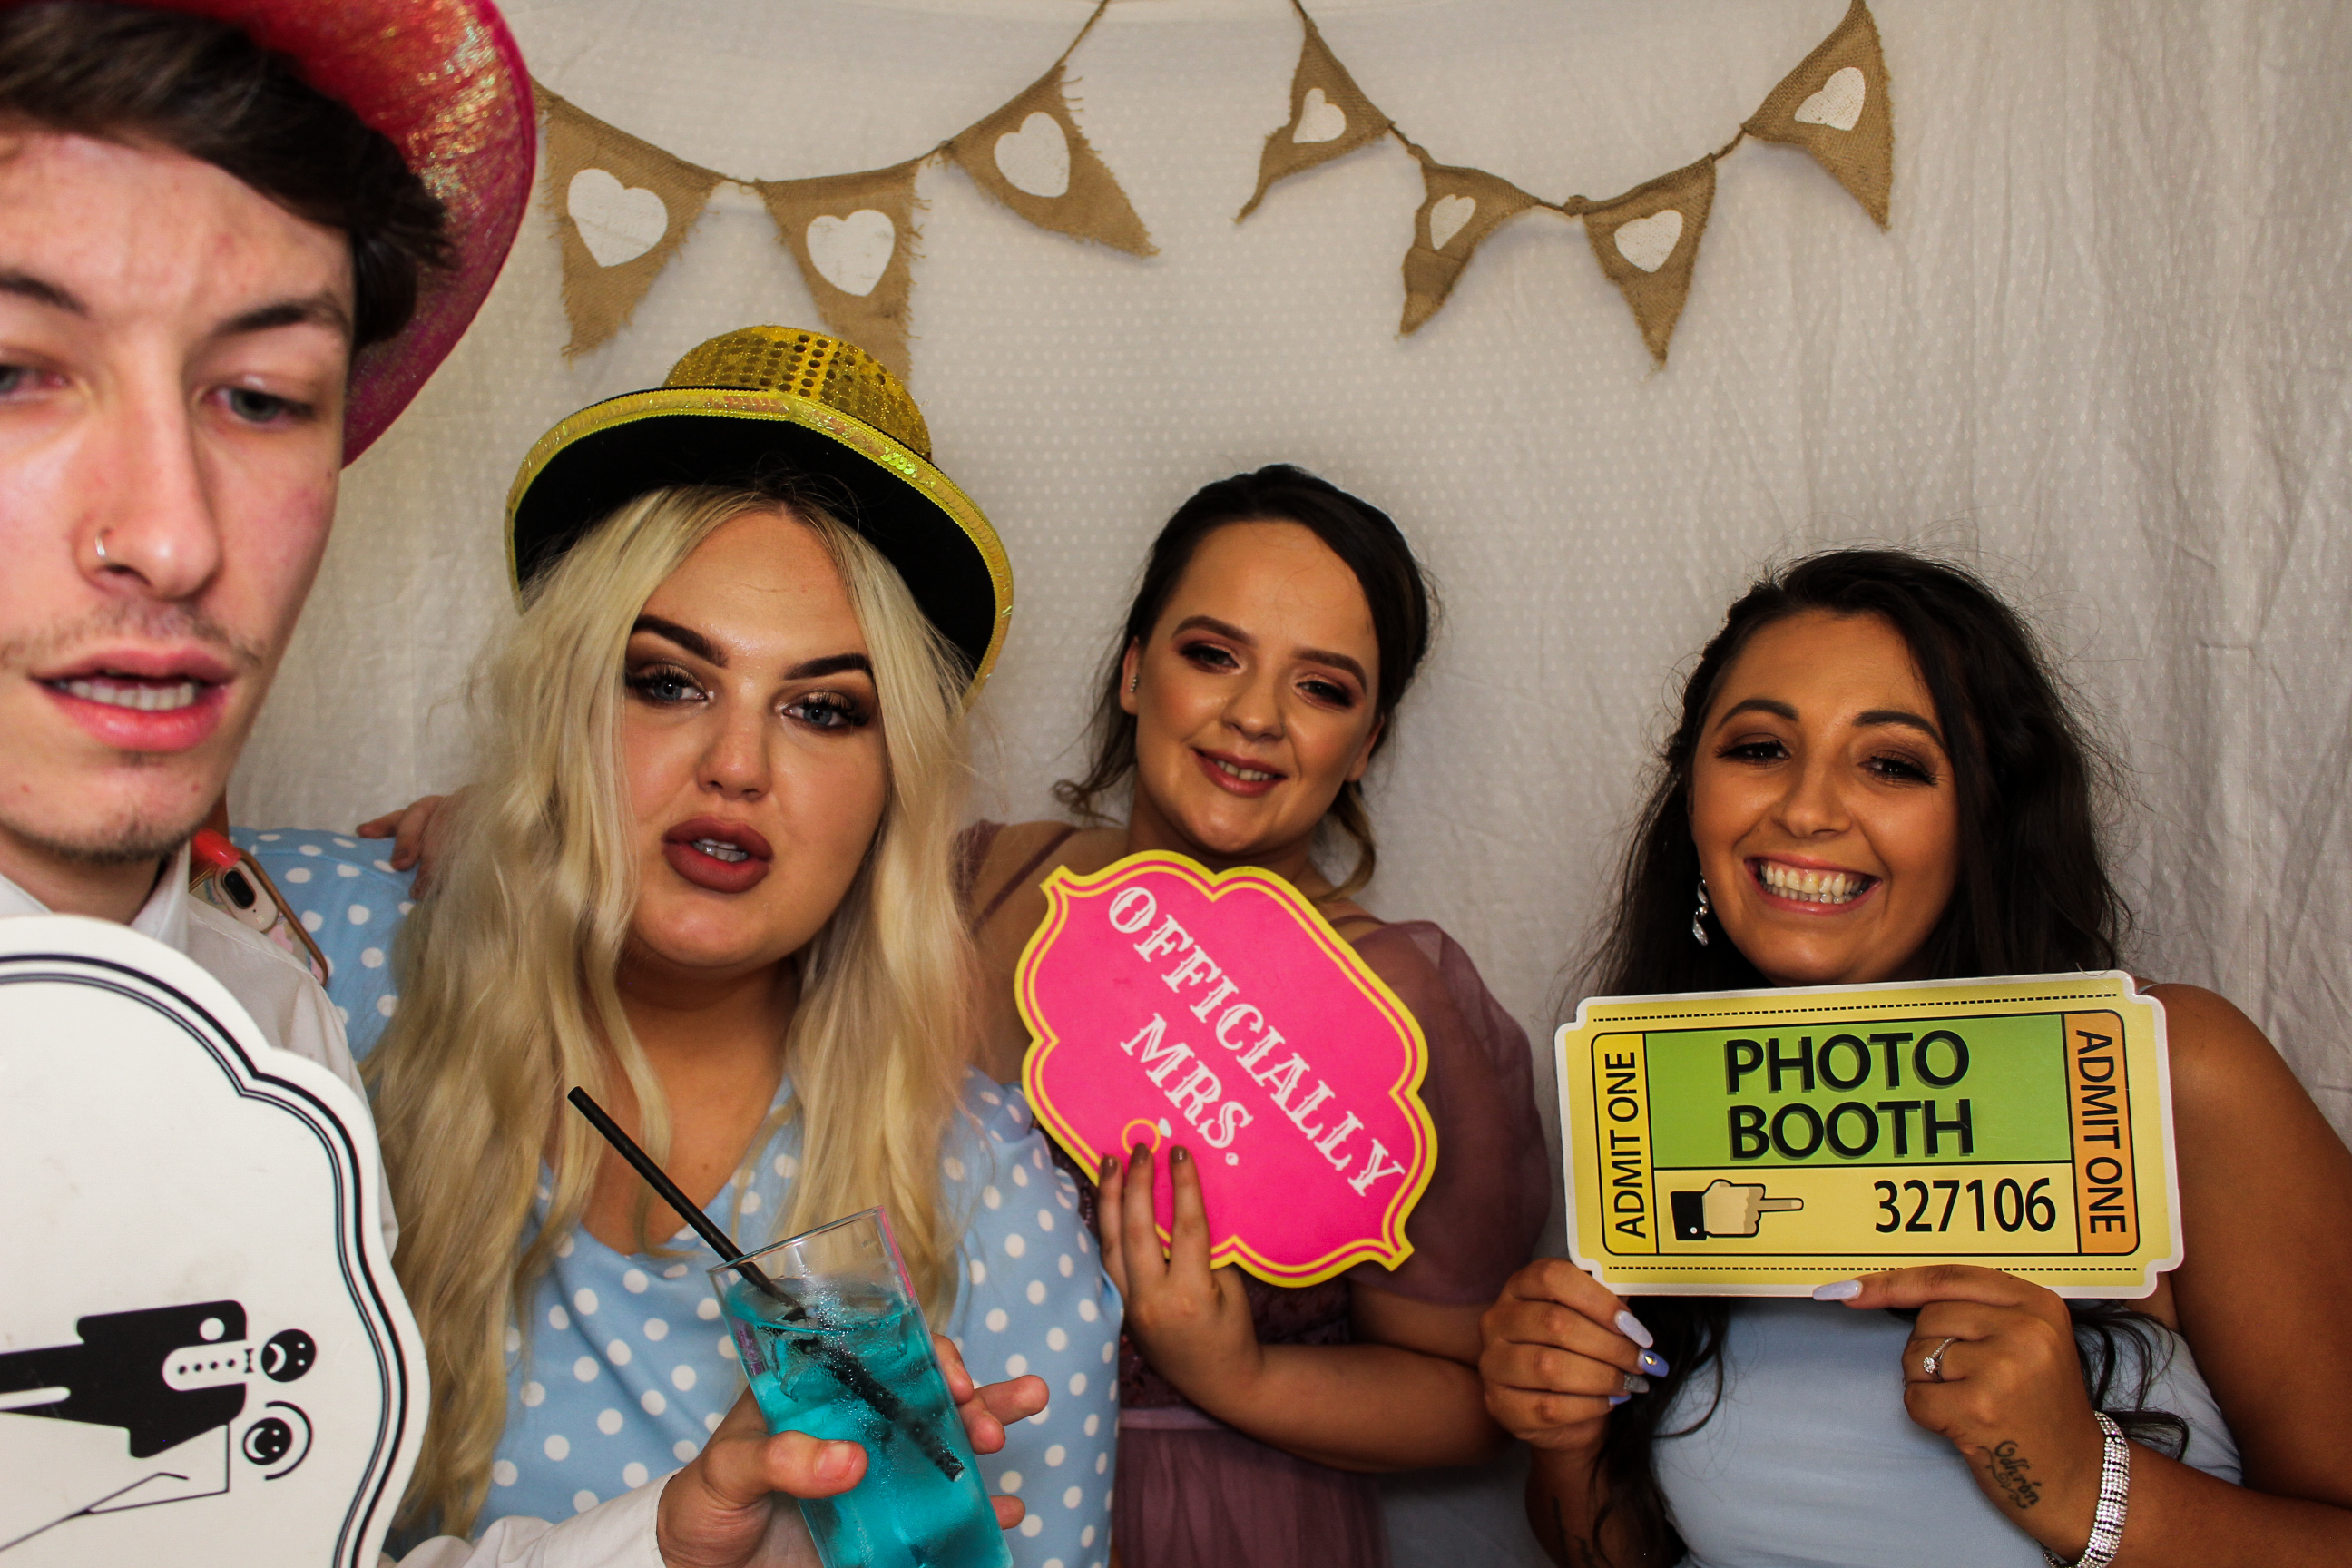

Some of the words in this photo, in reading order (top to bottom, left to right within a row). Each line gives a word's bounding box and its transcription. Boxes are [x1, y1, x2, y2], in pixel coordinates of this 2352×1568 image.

[1109, 886, 1406, 1197] OFFICIALLY
[1725, 1029, 1970, 1094] PHOTO
[1120, 1013, 1254, 1166] MRS.
[1604, 1051, 1639, 1122] ONE
[2075, 1029, 2121, 1150] ADMIT
[1728, 1098, 1975, 1161] BOOTH
[1611, 1126, 1647, 1240] ADMIT
[1874, 1177, 2057, 1234] 327106
[2086, 1156, 2126, 1235] ONE
